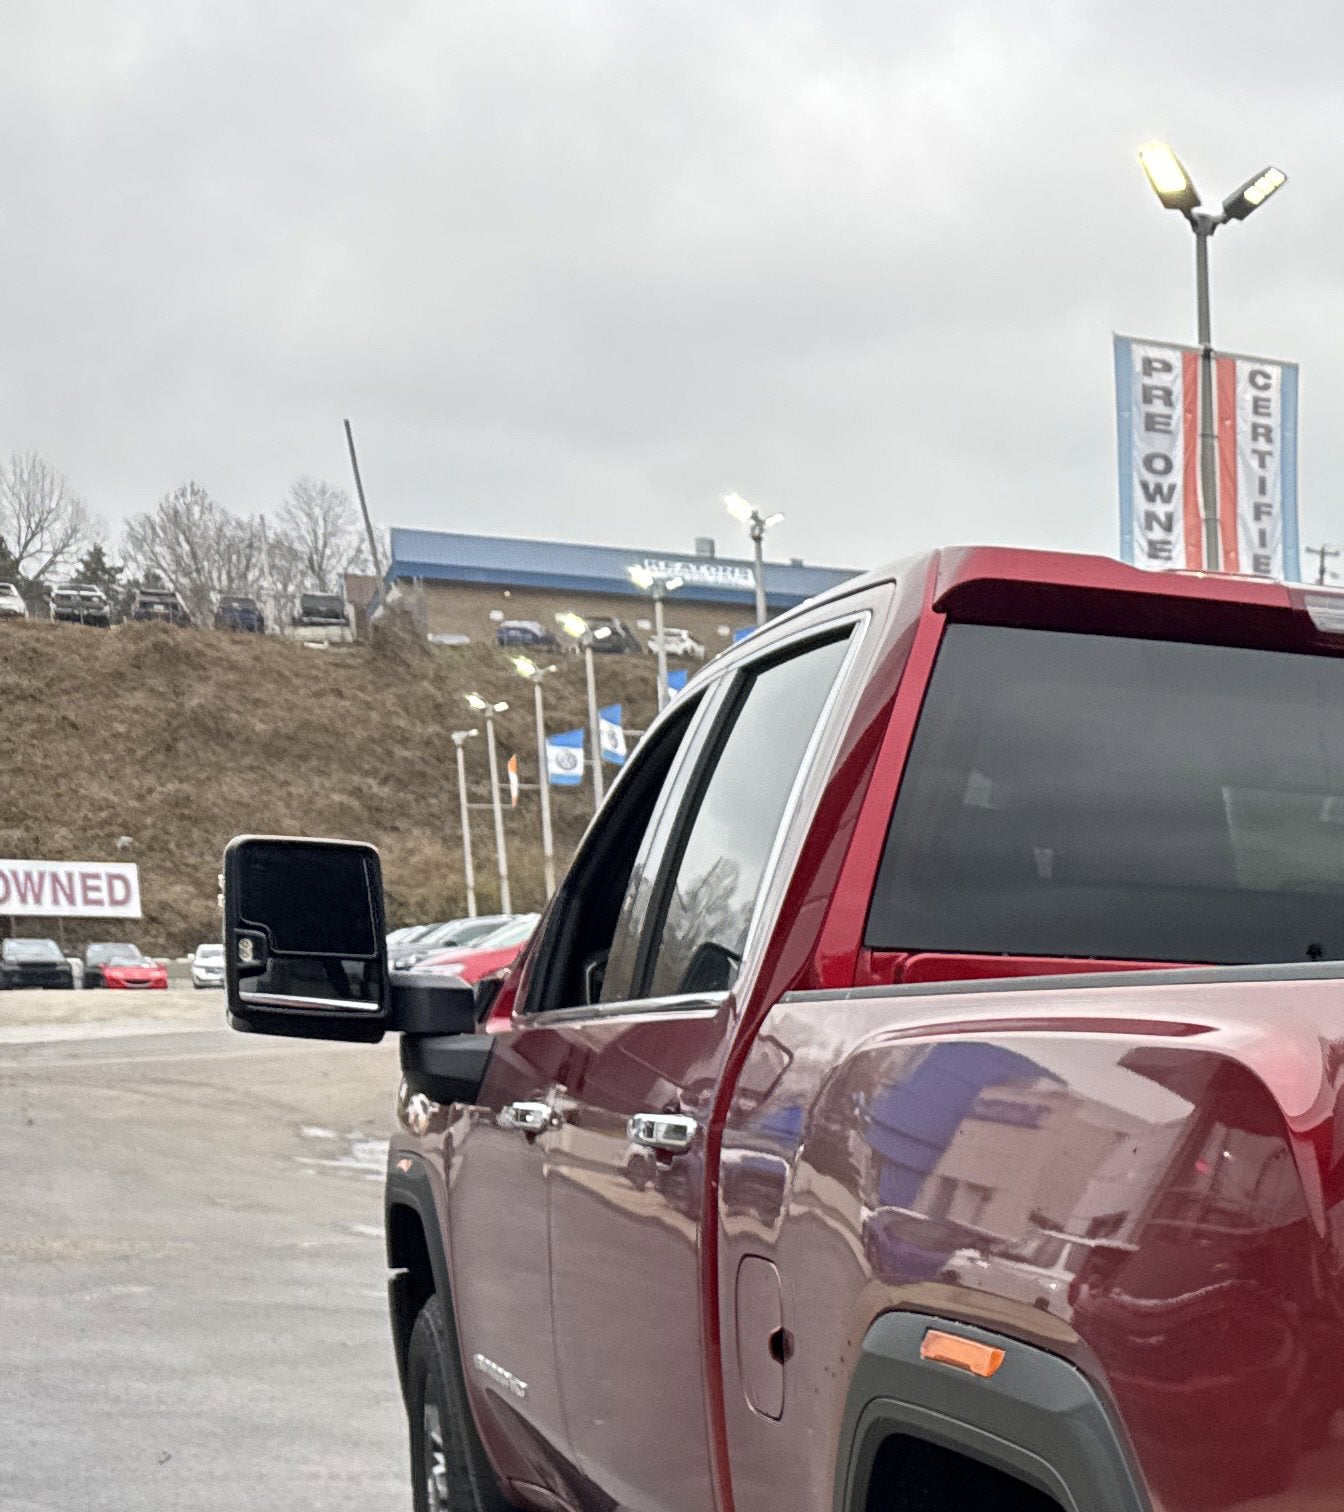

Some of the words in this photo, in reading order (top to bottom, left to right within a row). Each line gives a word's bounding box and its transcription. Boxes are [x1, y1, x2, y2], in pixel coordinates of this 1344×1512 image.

[1141, 357, 1173, 434] PRE
[1139, 452, 1176, 560] OWNE
[1248, 369, 1273, 574] CERTIFIE
